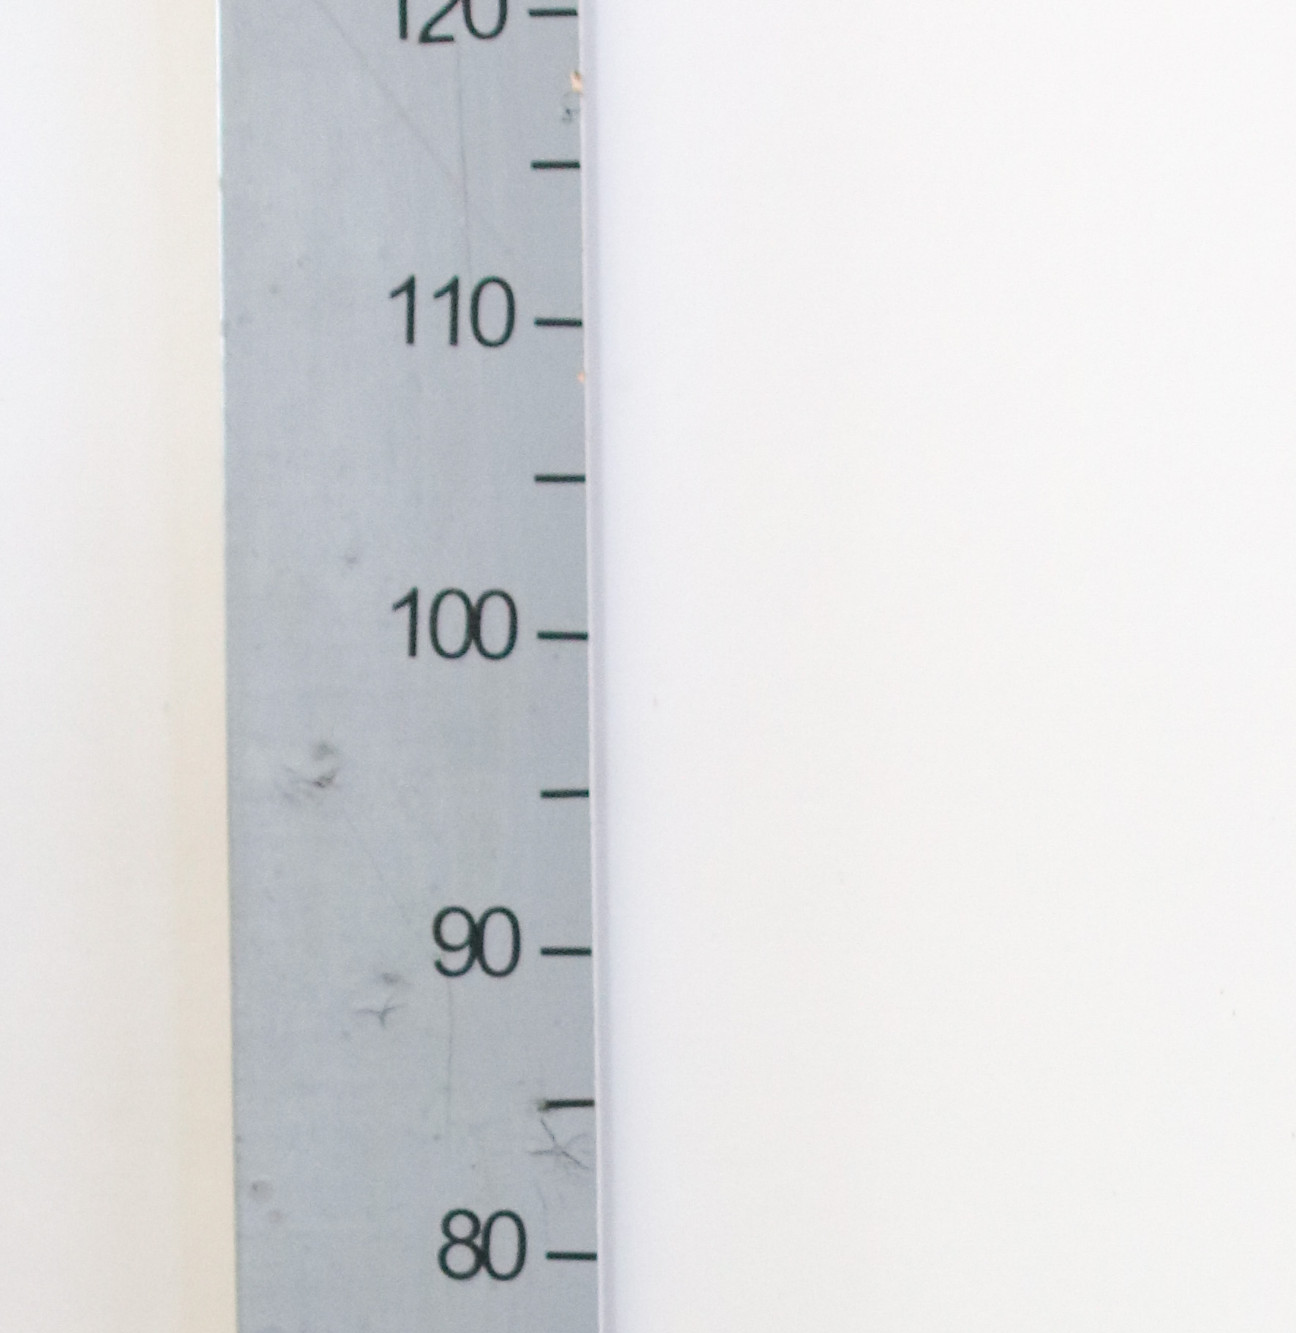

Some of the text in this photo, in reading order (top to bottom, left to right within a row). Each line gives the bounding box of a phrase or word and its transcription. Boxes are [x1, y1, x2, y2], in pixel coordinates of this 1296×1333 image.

[389, 274, 516, 348] 110
[391, 586, 519, 660] 100
[431, 906, 522, 978] 90
[438, 1209, 527, 1282] 80
